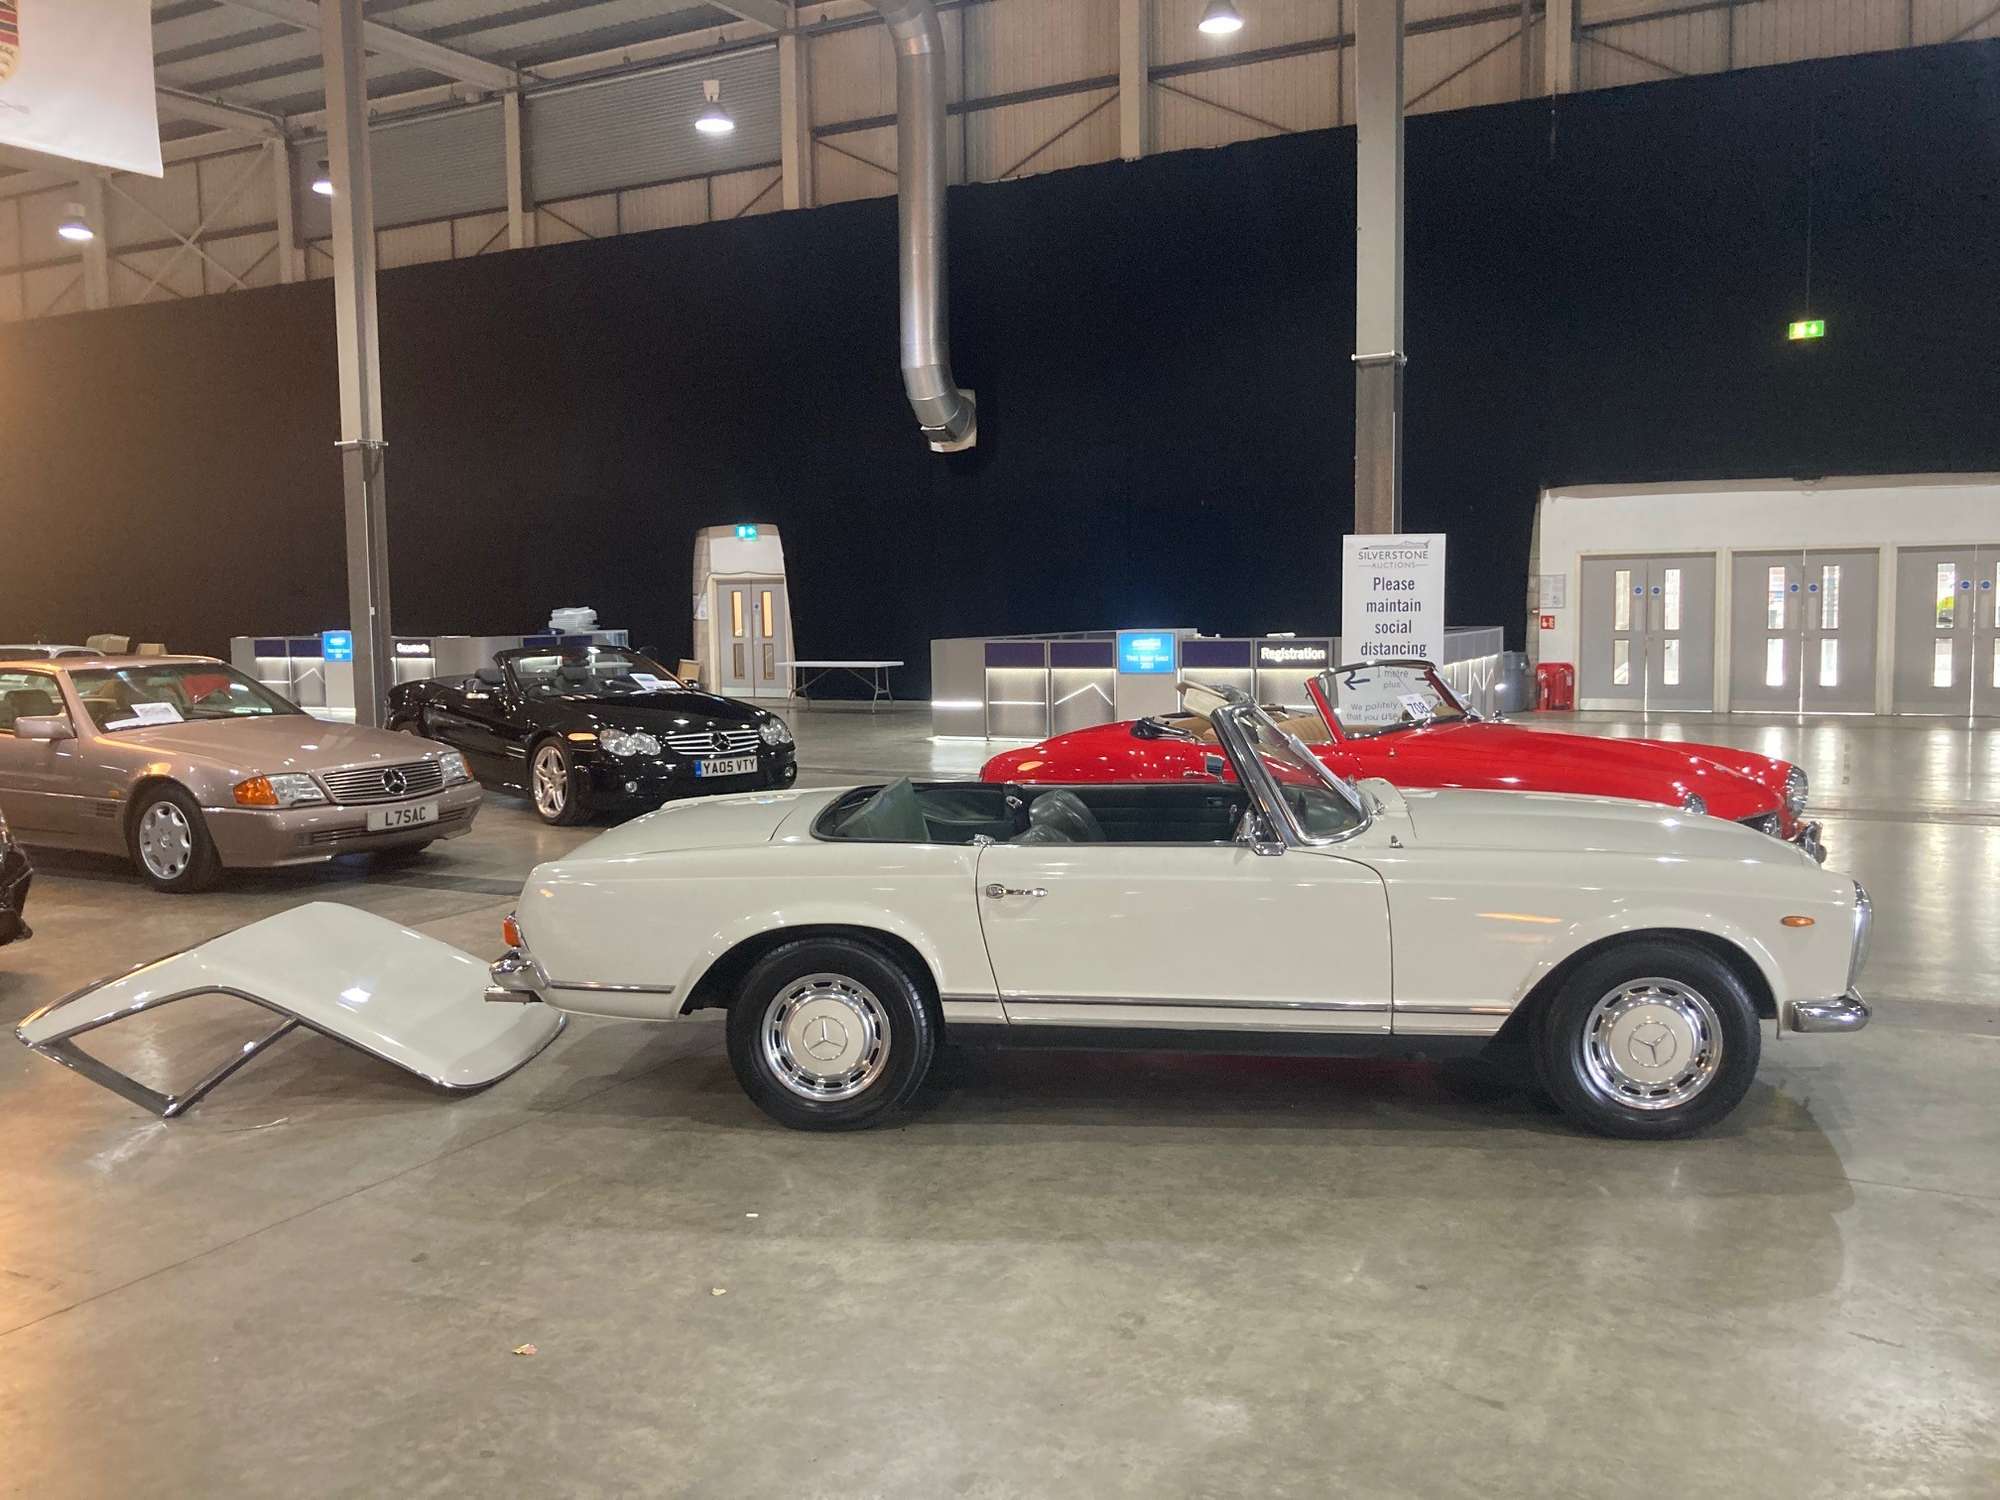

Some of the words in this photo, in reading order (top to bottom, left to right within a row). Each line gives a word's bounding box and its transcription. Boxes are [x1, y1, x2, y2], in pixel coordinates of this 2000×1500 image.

[1358, 550, 1429, 560] SILVERSTONE
[1373, 577, 1415, 591] Please
[1366, 598, 1422, 613] maintain
[1375, 619, 1412, 634] social
[1260, 646, 1326, 662] Registration
[1360, 641, 1427, 657] distancing
[1365, 702, 1398, 711] politely
[1407, 702, 1429, 714] 708
[703, 761, 733, 774] YA05
[736, 759, 755, 771] VTY
